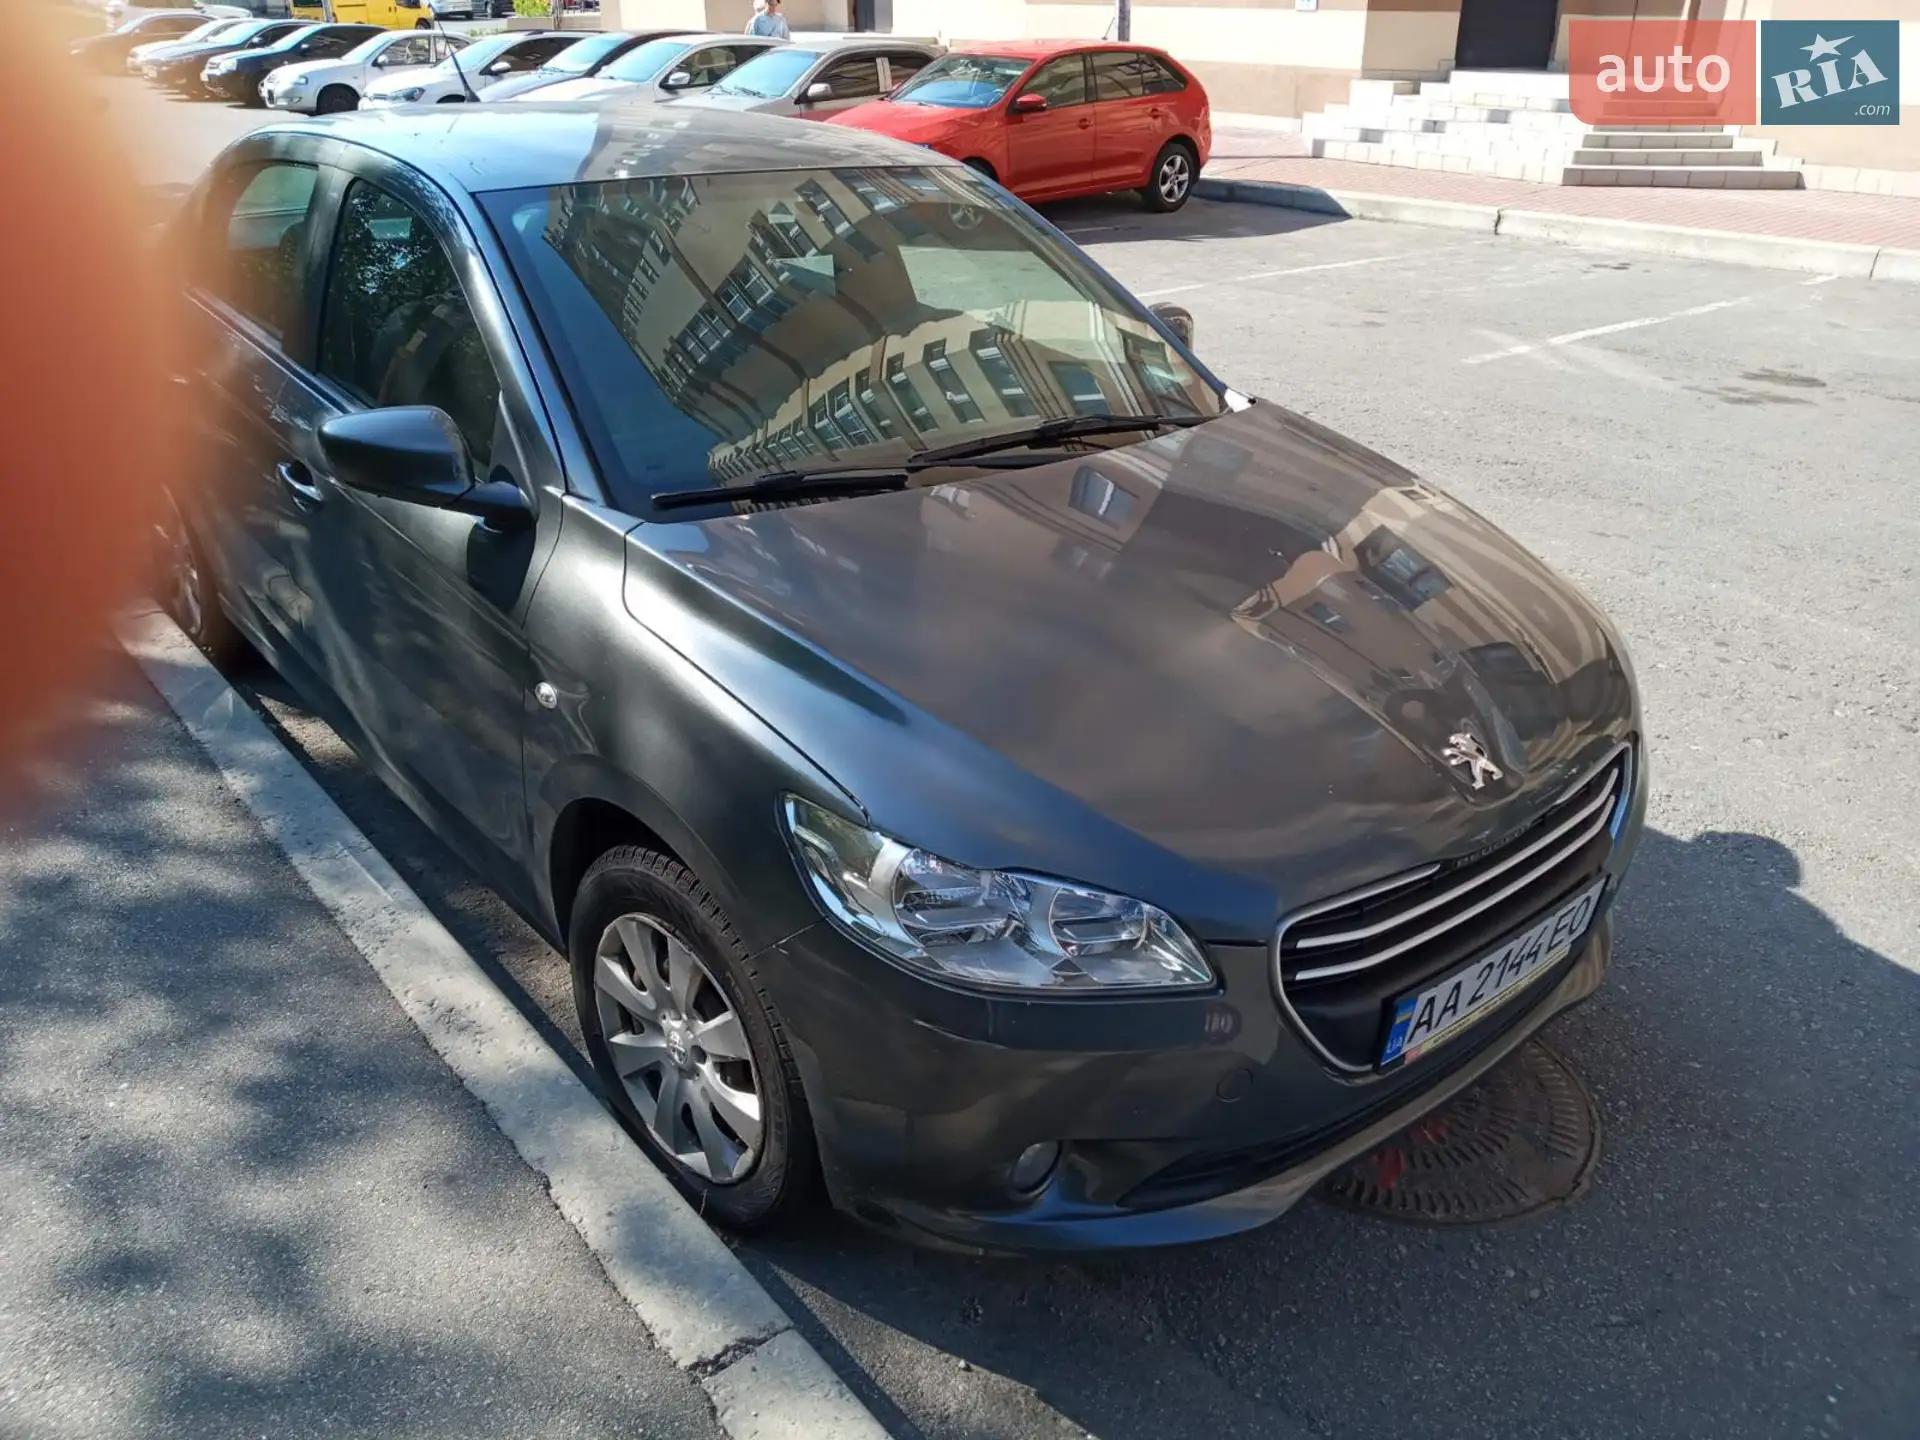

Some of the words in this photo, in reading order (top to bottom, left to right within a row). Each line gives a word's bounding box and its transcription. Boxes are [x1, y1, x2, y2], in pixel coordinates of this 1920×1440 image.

[1406, 980, 1462, 1045] AA
[1467, 925, 1549, 1007] 2144
[1547, 895, 1592, 954] EO
